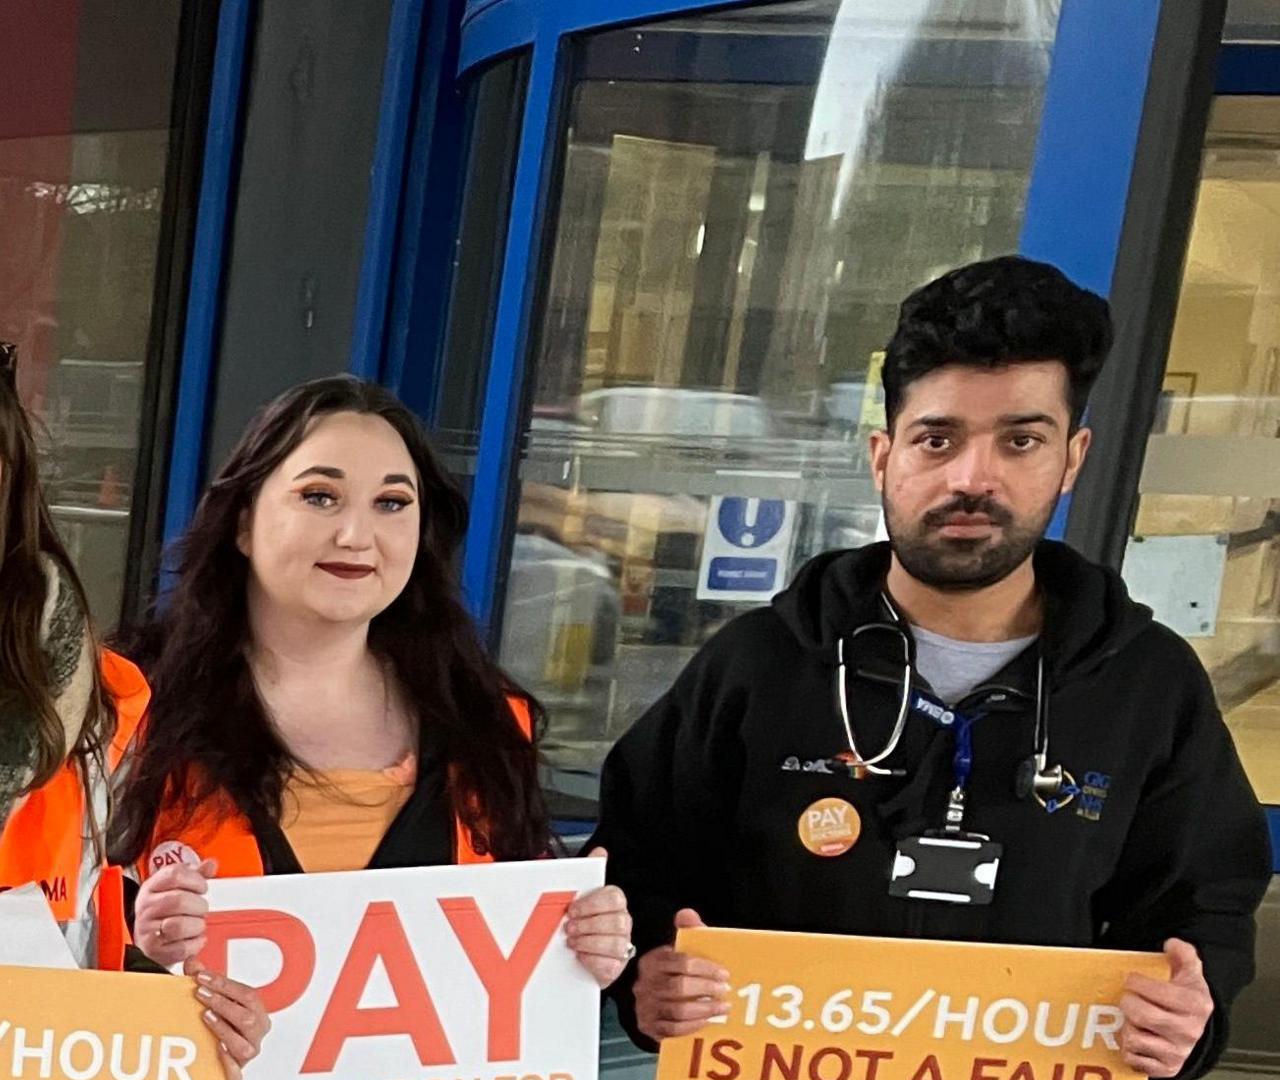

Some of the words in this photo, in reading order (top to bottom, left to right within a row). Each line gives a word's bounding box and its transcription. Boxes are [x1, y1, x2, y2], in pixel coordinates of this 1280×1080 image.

[807, 805, 849, 830] PAY
[40, 876, 68, 902] MA
[196, 890, 578, 1074] PAY
[705, 983, 1125, 1052] 13.65/HOUR
